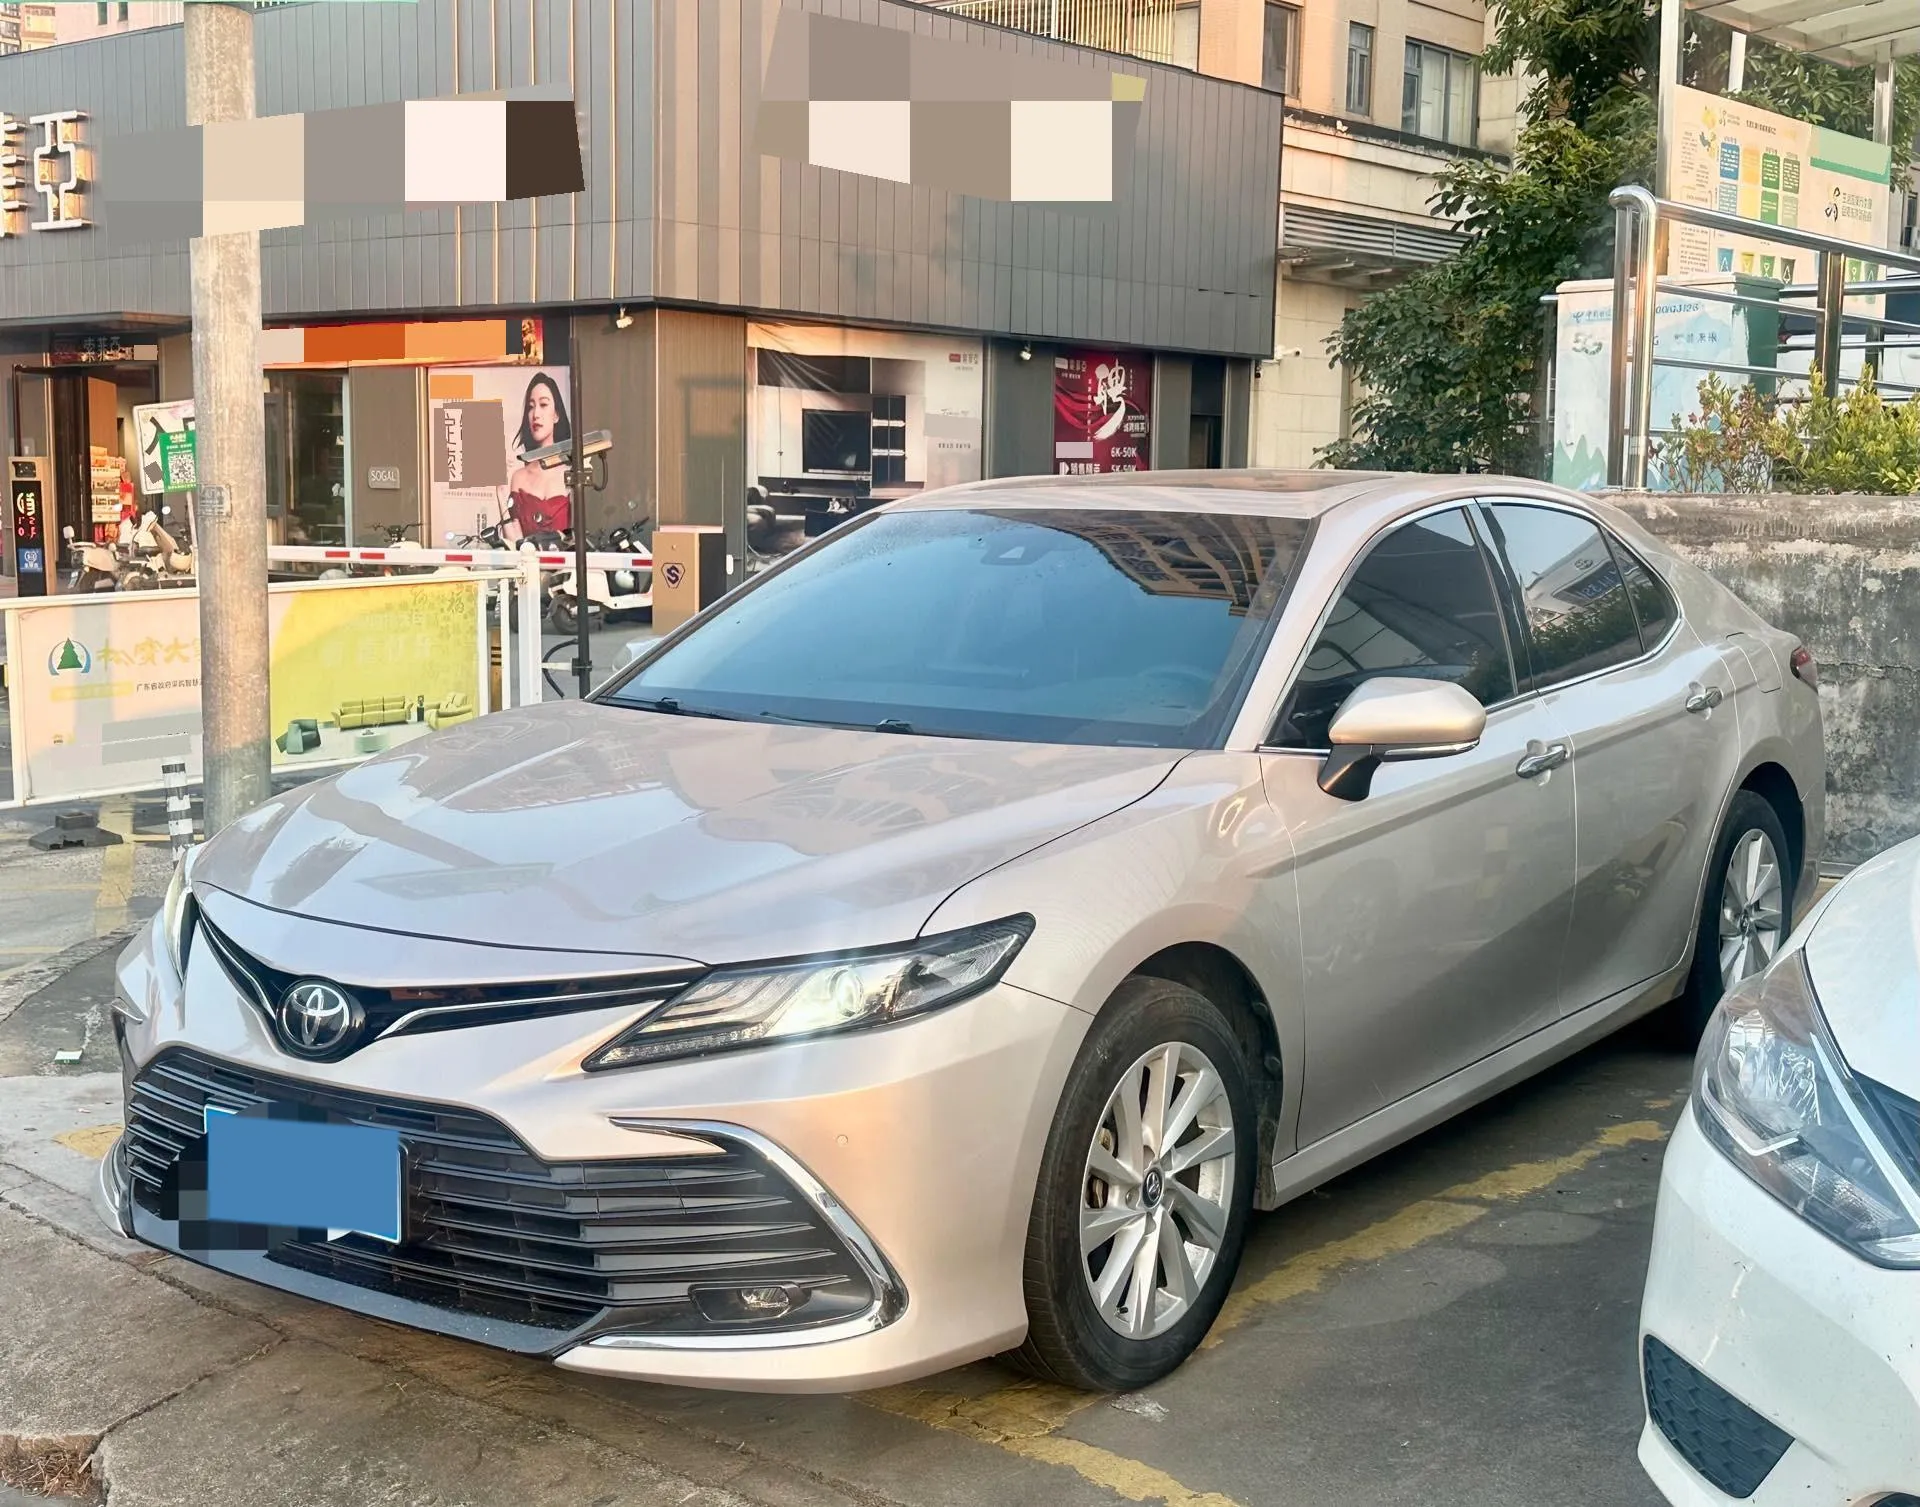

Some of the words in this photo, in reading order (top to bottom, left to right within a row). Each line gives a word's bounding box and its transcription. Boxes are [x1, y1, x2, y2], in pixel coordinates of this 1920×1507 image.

[1093, 357, 1128, 440] 聘
[1111, 446, 1137, 458] 6K-50K
[371, 470, 397, 482] SOGAL
[136, 677, 202, 693] 广东省政府采购智慧
